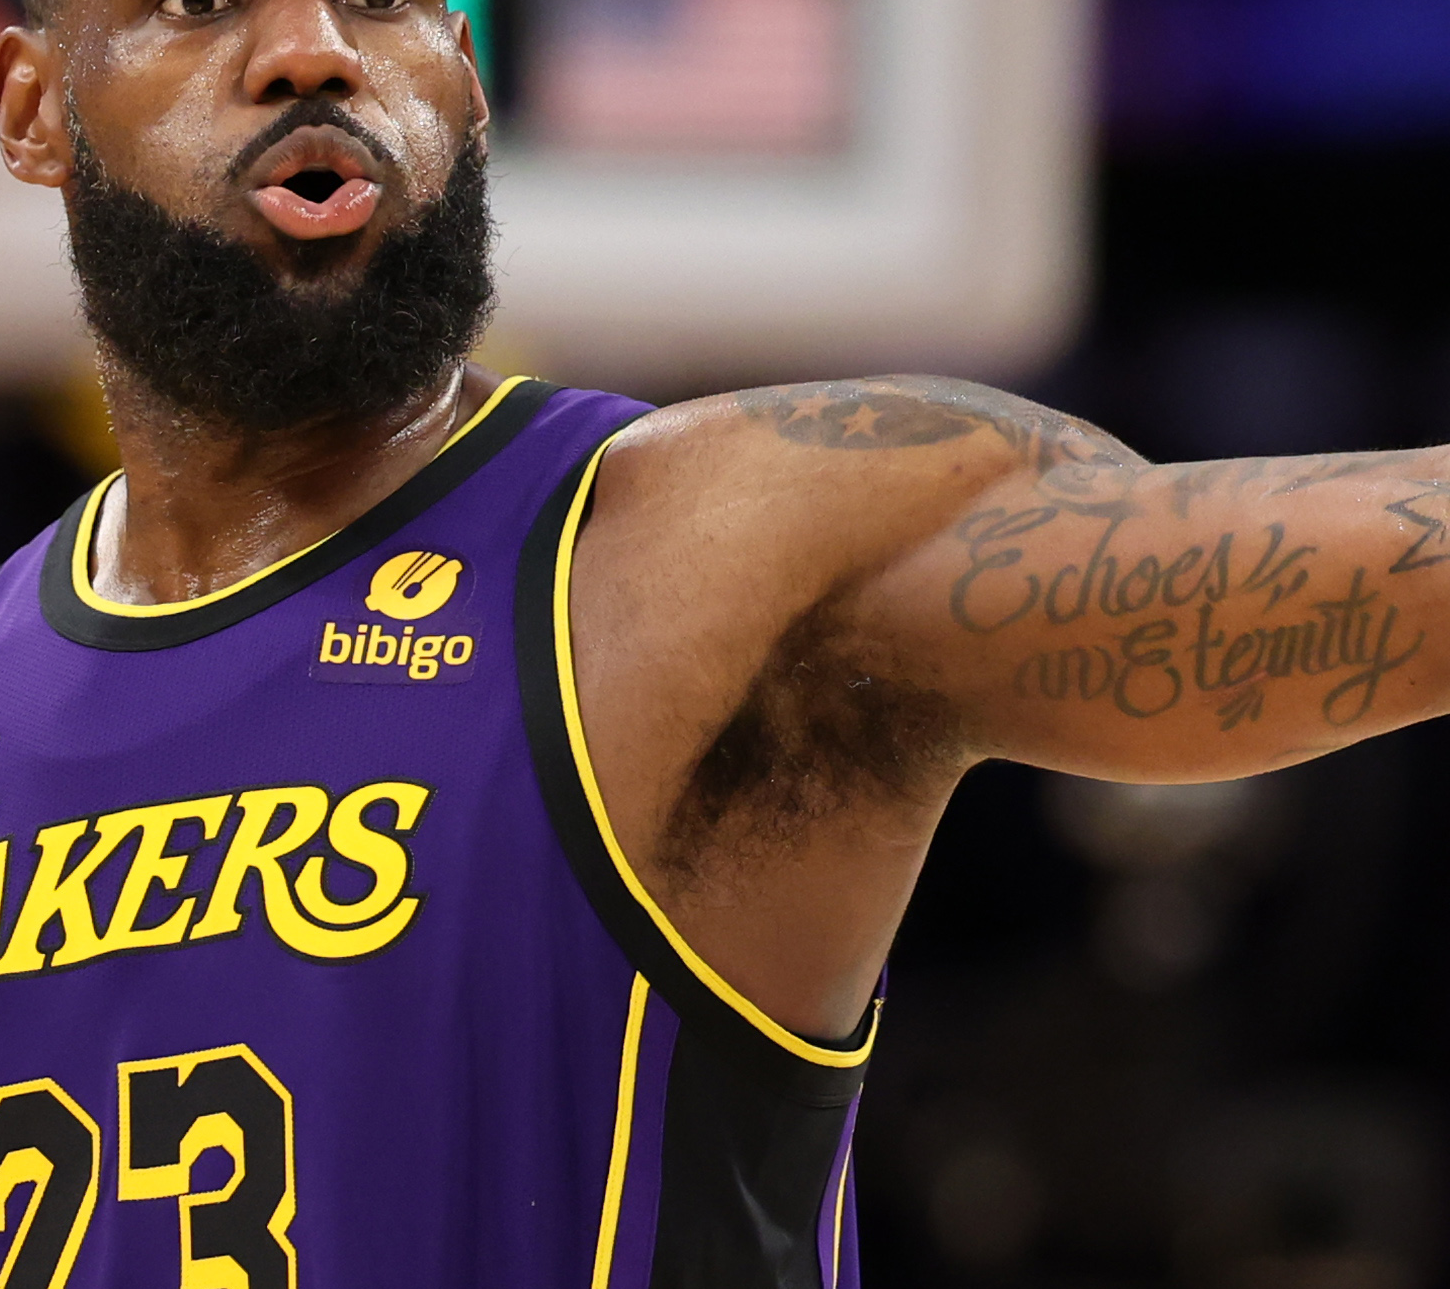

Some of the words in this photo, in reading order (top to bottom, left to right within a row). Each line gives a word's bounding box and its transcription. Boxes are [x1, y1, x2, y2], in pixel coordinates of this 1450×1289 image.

[948, 500, 1235, 634] Echoes
[318, 622, 474, 680] bibigo
[1112, 566, 1426, 728] Eternity
